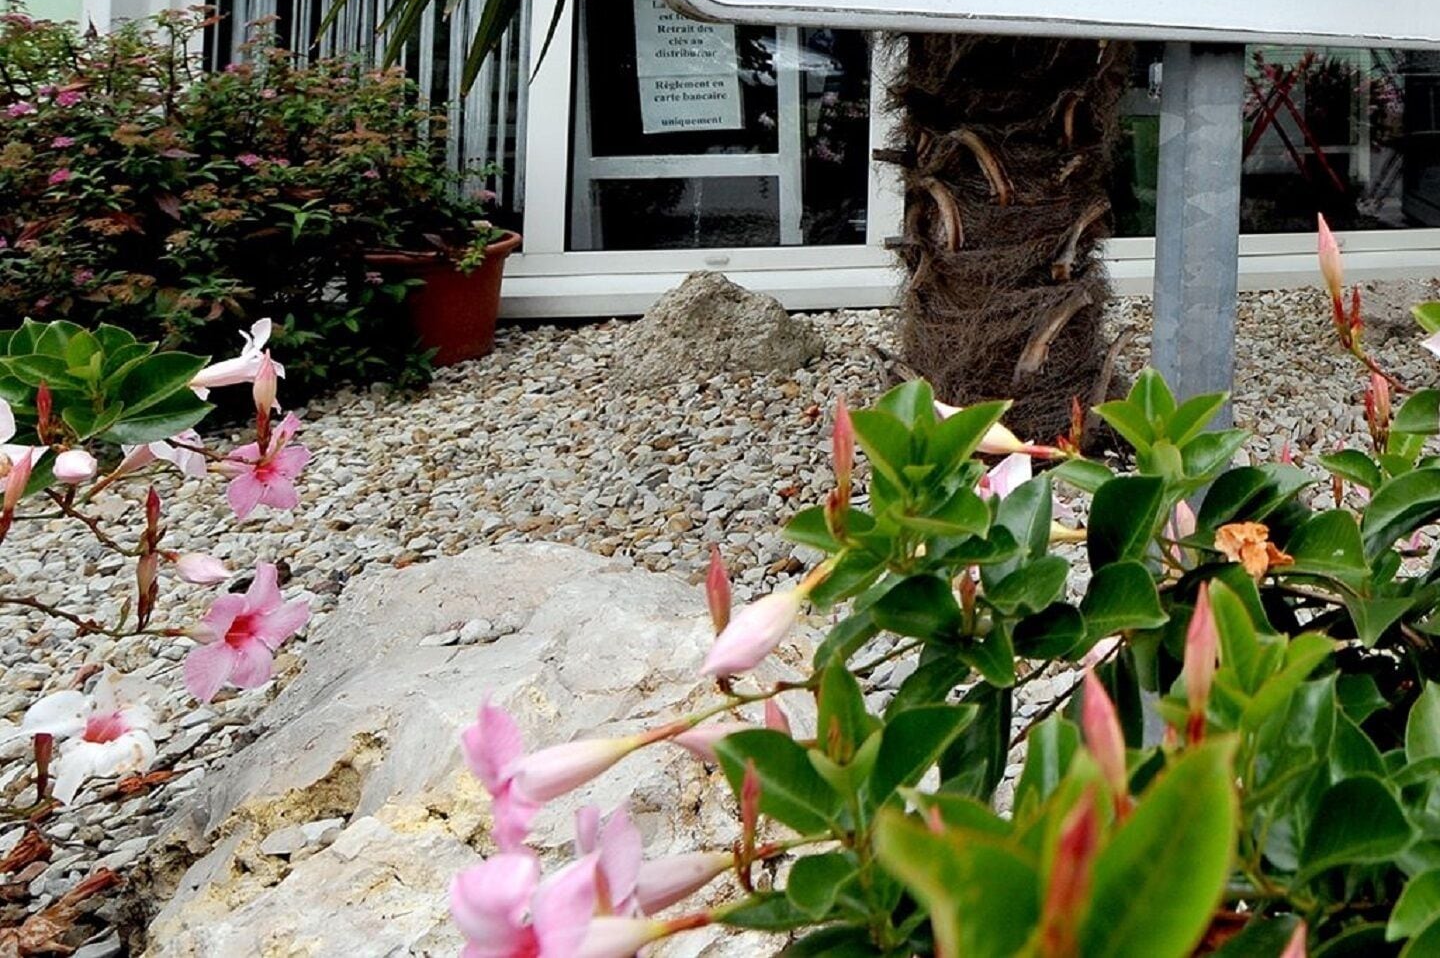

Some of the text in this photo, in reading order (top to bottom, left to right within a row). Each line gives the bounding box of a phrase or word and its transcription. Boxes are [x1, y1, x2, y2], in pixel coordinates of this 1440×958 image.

[657, 24, 714, 34] Retrait des
[668, 36, 688, 46] clés
[655, 79, 725, 90] Règlement en
[653, 91, 728, 103] carte bancaire
[661, 115, 722, 127] uniquement
